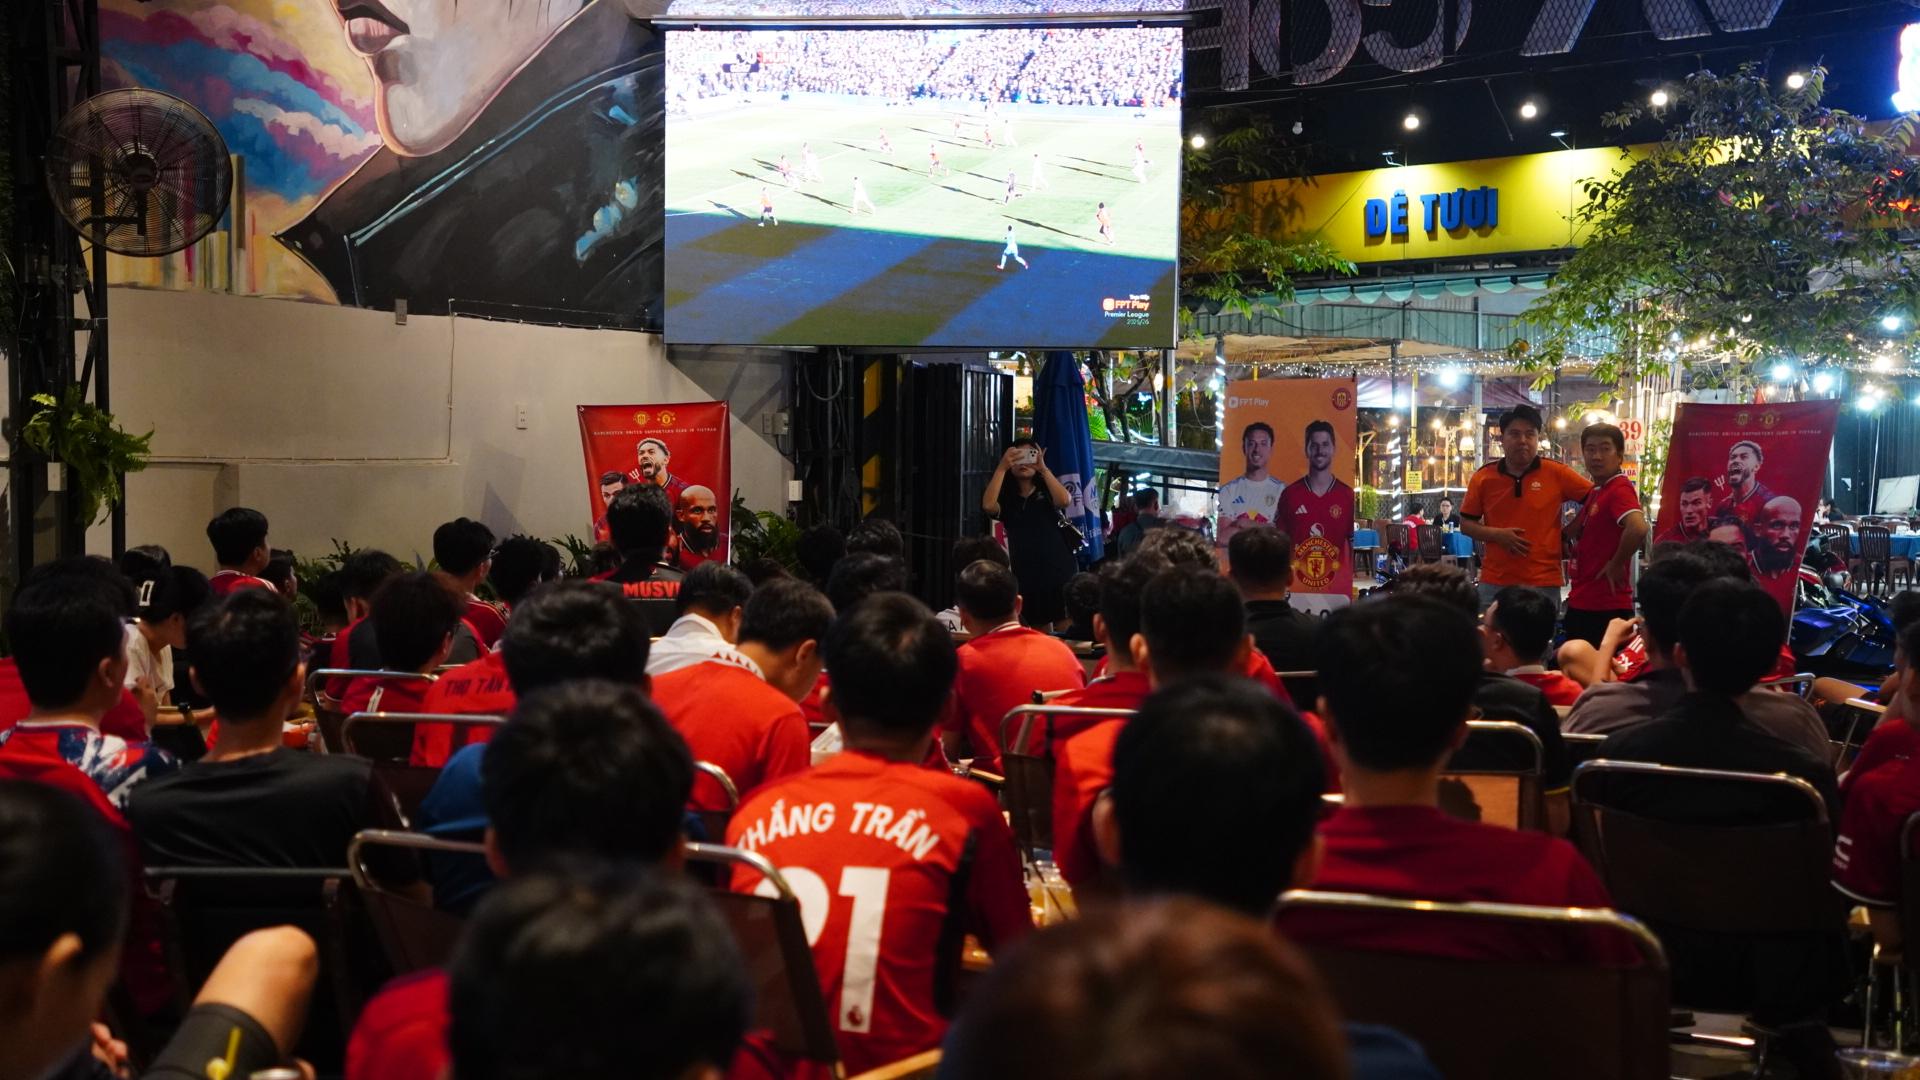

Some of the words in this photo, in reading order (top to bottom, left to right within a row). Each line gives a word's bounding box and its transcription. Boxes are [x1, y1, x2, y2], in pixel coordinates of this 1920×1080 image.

[1366, 188, 1409, 237] DÊ
[1420, 186, 1498, 232] TƯƠI
[1115, 300, 1131, 309] FPT
[1131, 300, 1149, 311] Play
[1127, 311, 1149, 319] League
[1239, 398, 1253, 407] FPT
[1254, 398, 1270, 408] Play
[1297, 538, 1337, 557] MANCHESTER
[1302, 577, 1330, 587] UNITED
